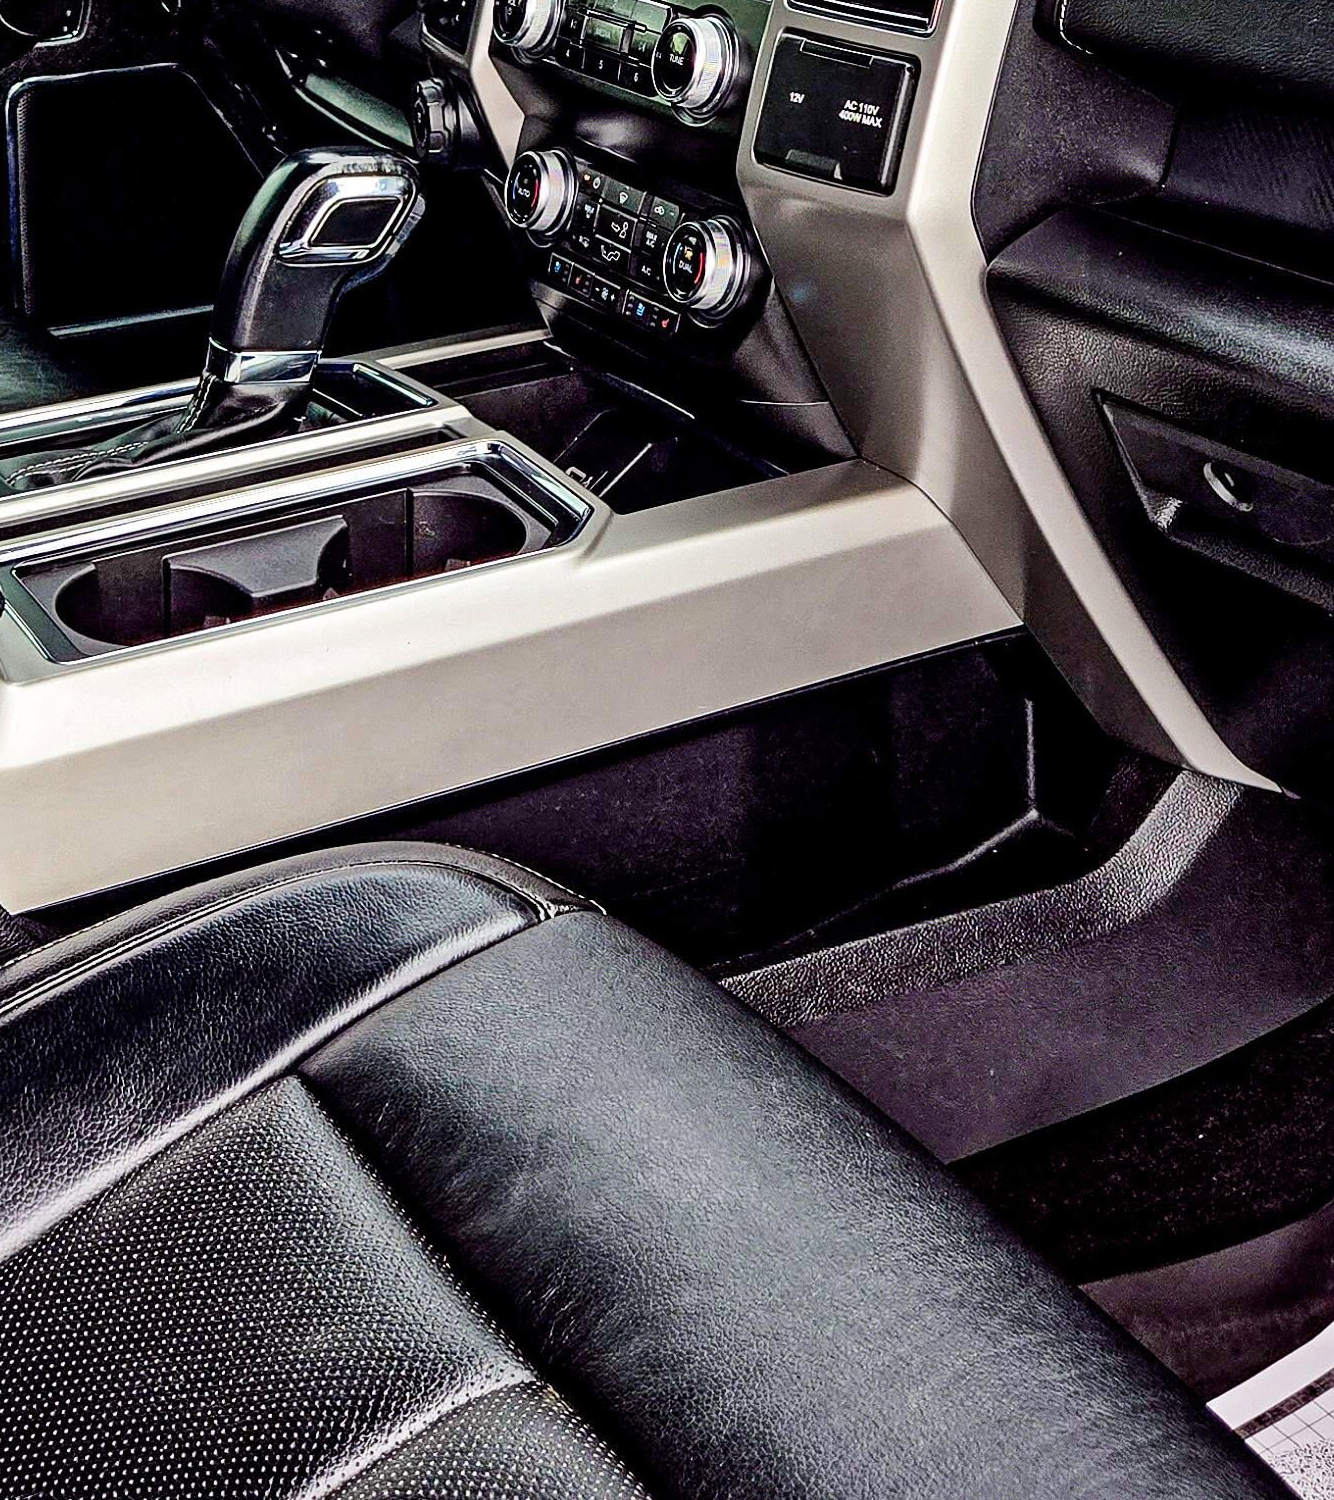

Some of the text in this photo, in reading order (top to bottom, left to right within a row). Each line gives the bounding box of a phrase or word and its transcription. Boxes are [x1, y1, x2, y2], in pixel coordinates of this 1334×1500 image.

[610, 0, 618, 10] 2
[565, 49, 570, 58] 4
[669, 53, 685, 66] TUNE
[598, 60, 604, 71] 5
[633, 71, 639, 83] 6
[789, 92, 805, 104] 12V
[844, 99, 880, 116] AC 110V
[838, 109, 883, 129] 400W MAX
[517, 186, 531, 198] AUTO
[641, 265, 652, 276] A/C
[678, 260, 693, 274] DUAL
